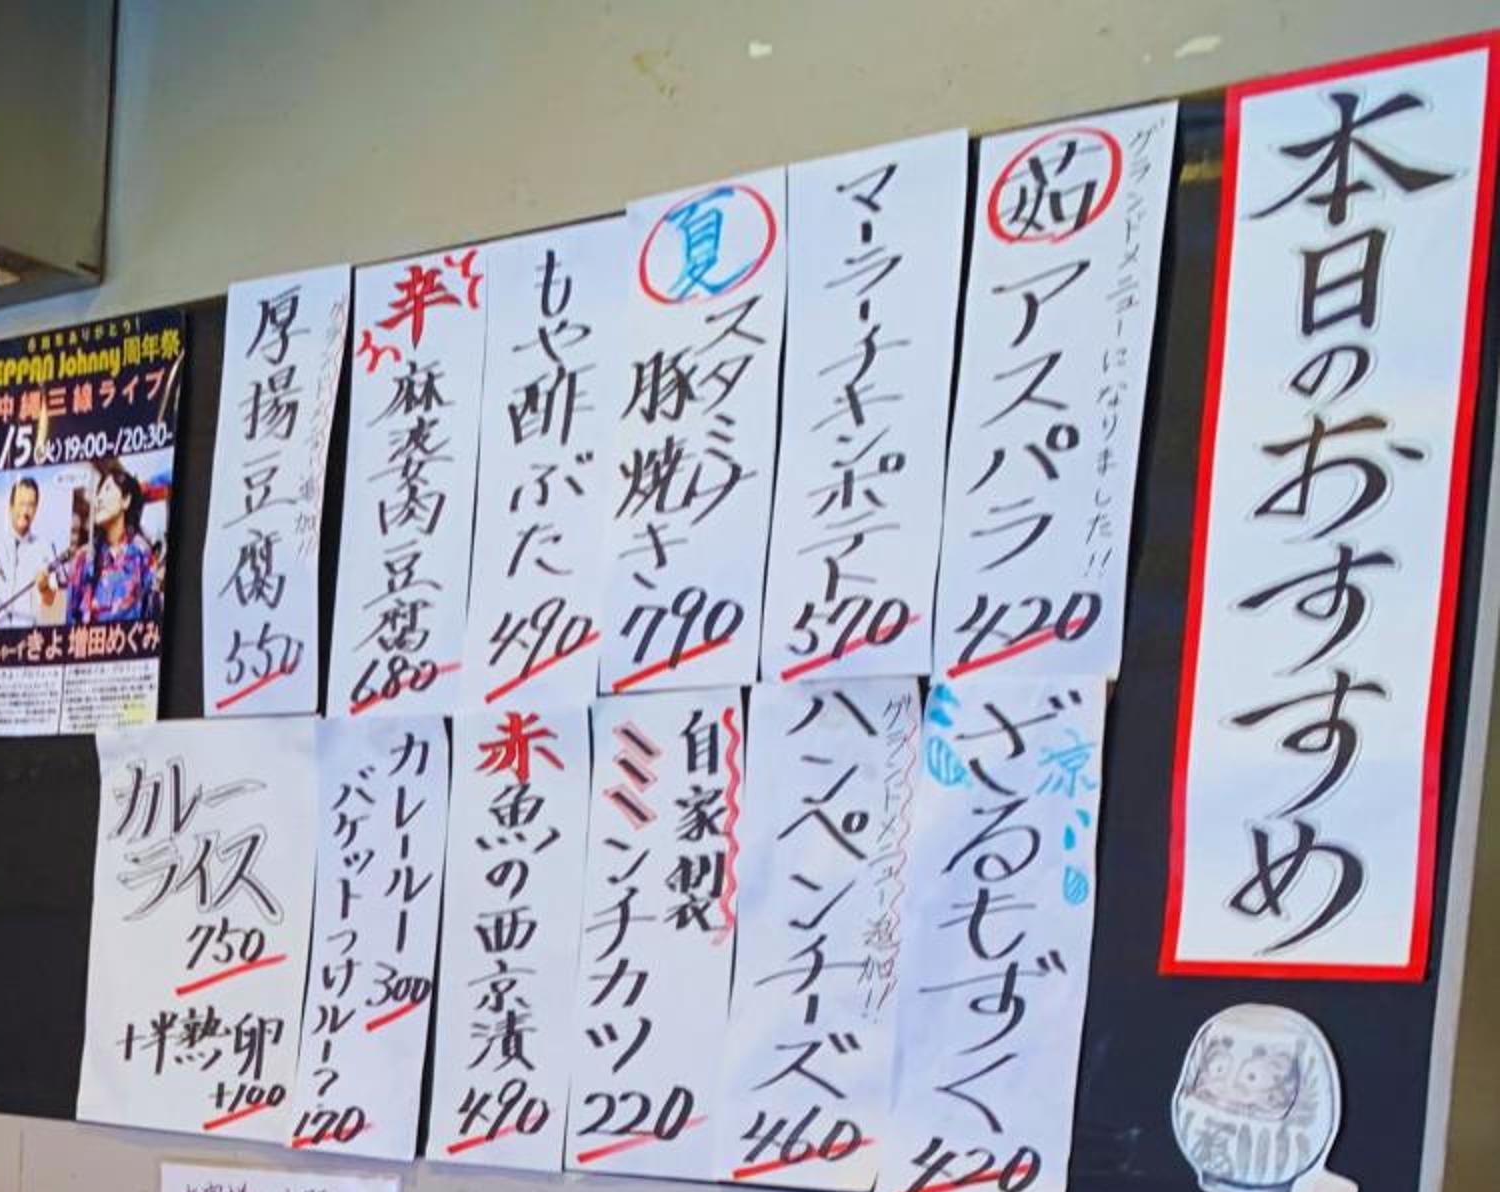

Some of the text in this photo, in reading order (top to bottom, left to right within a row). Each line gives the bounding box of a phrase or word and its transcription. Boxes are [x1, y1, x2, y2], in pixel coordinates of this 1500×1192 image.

[655, 184, 762, 301] 夏
[219, 284, 311, 686] 厚揚豆腐 550
[786, 163, 911, 659] マーラーチキンポテト 570
[970, 259, 1092, 572] アスパラ
[1222, 90, 1468, 957] 本日のおすすめ
[351, 655, 440, 705] 680
[488, 597, 593, 679] 490
[618, 586, 745, 669] 790
[955, 592, 1102, 665] 420
[663, 709, 729, 933] 自家製
[185, 916, 266, 970] 750
[365, 961, 432, 1007] 300
[458, 711, 565, 1141] 赤魚の西京漬 490
[740, 690, 879, 1165] ハンペンチーズ 460
[918, 690, 1084, 1135] ざるもずく
[576, 1086, 696, 1141] 220
